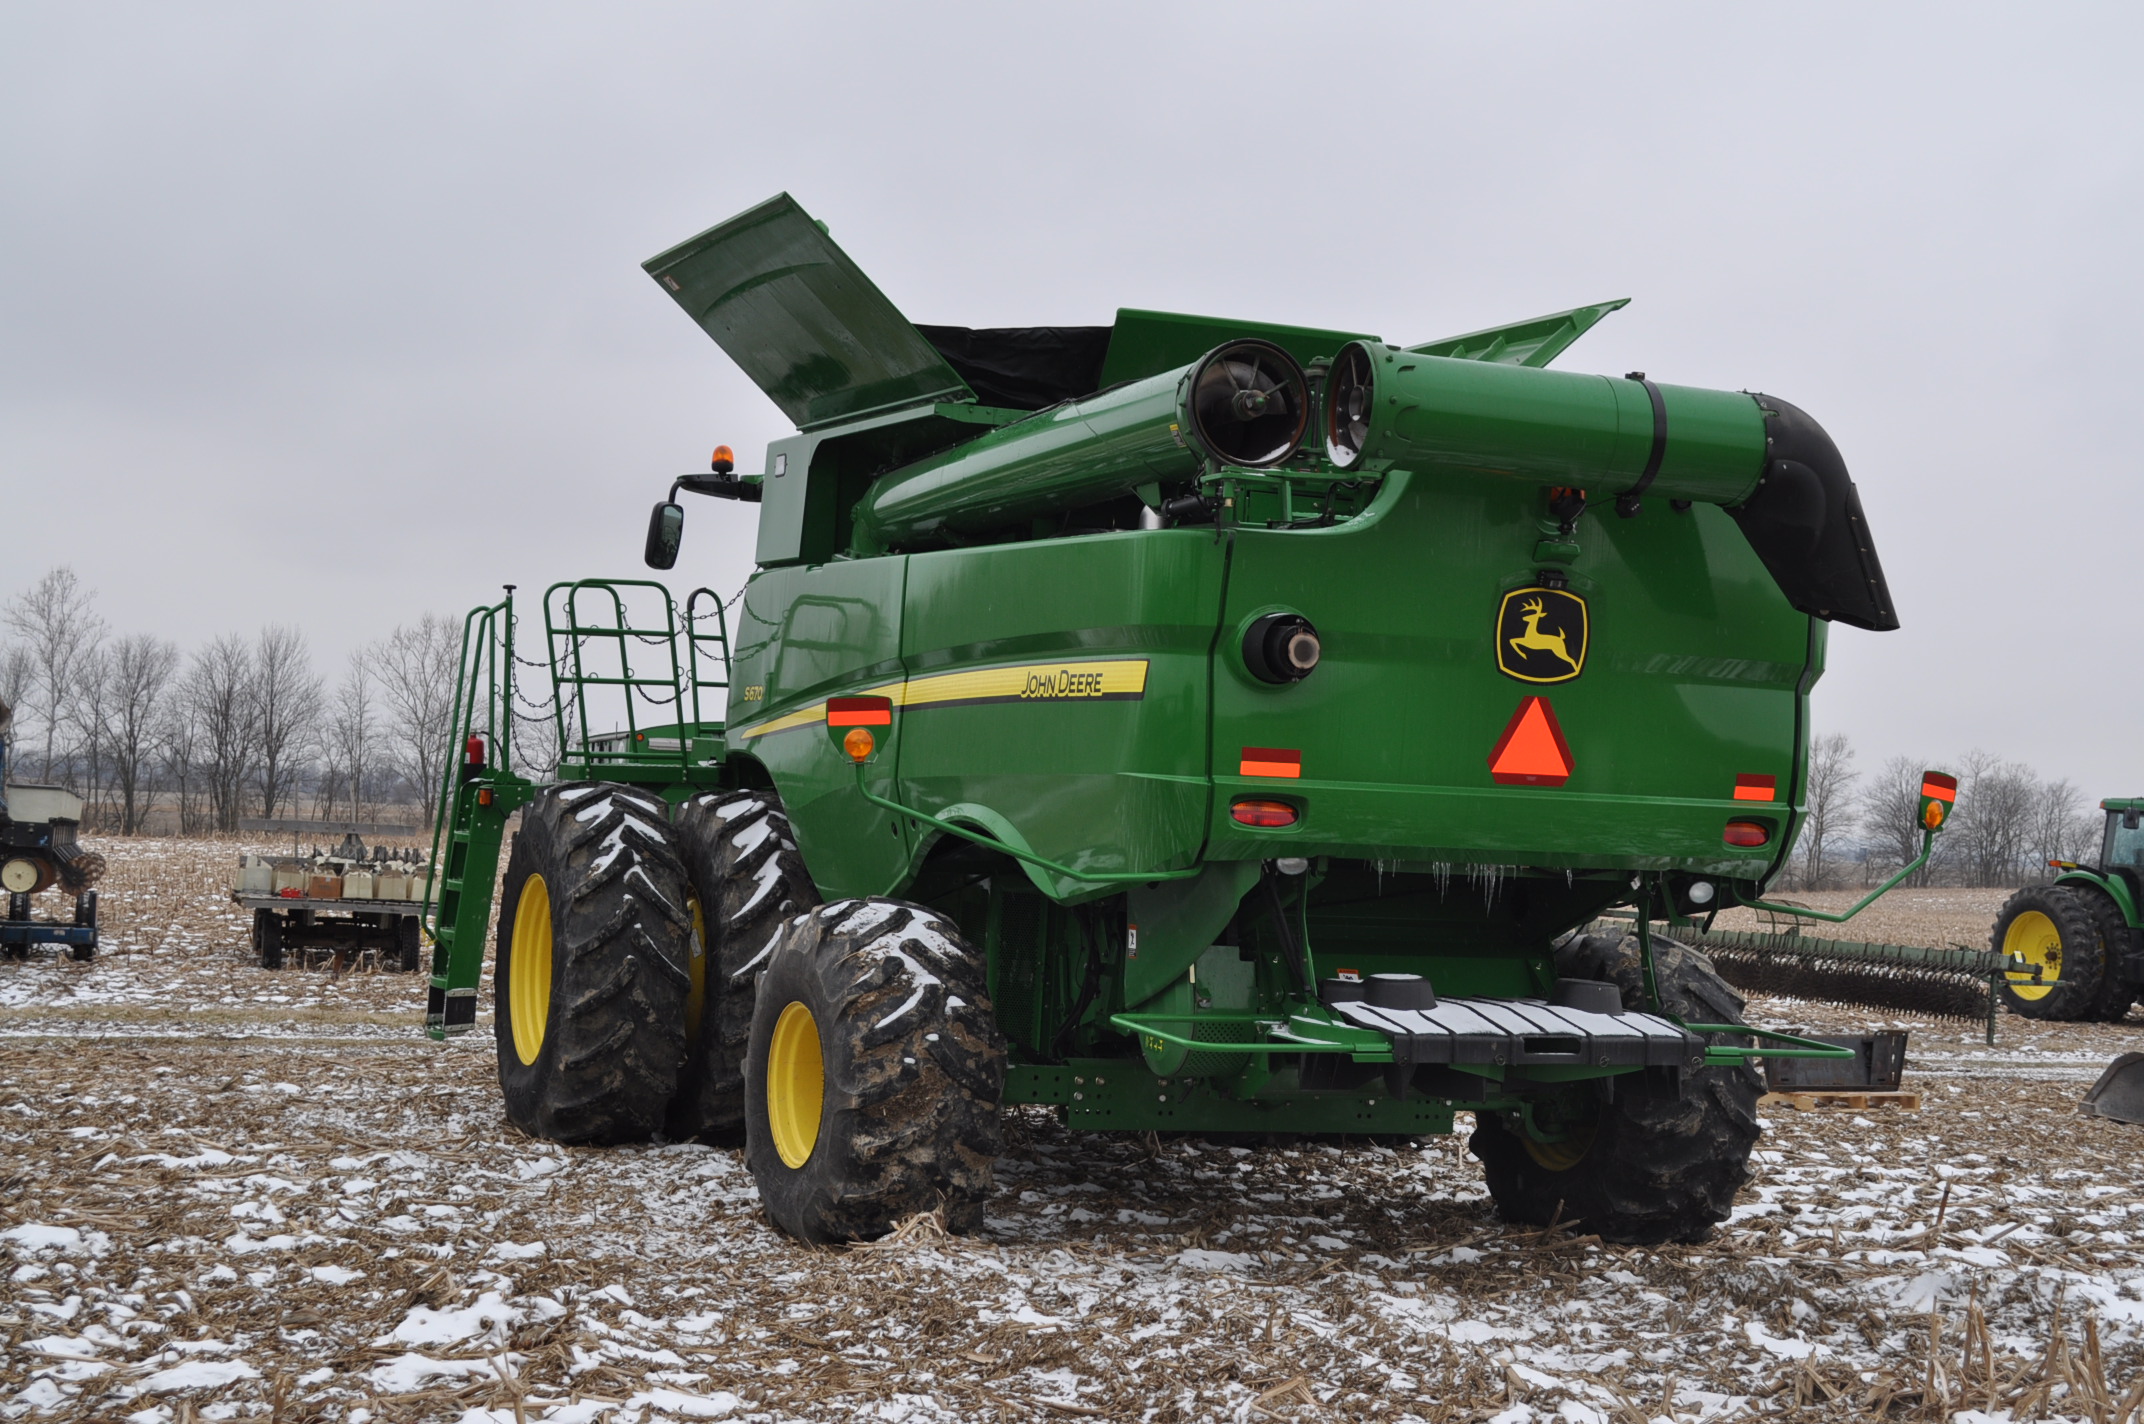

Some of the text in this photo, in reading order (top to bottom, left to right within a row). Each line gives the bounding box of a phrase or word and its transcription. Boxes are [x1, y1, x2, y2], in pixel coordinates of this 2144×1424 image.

[1021, 669, 1103, 695] JOHN DEERE
[744, 685, 764, 702] S670
